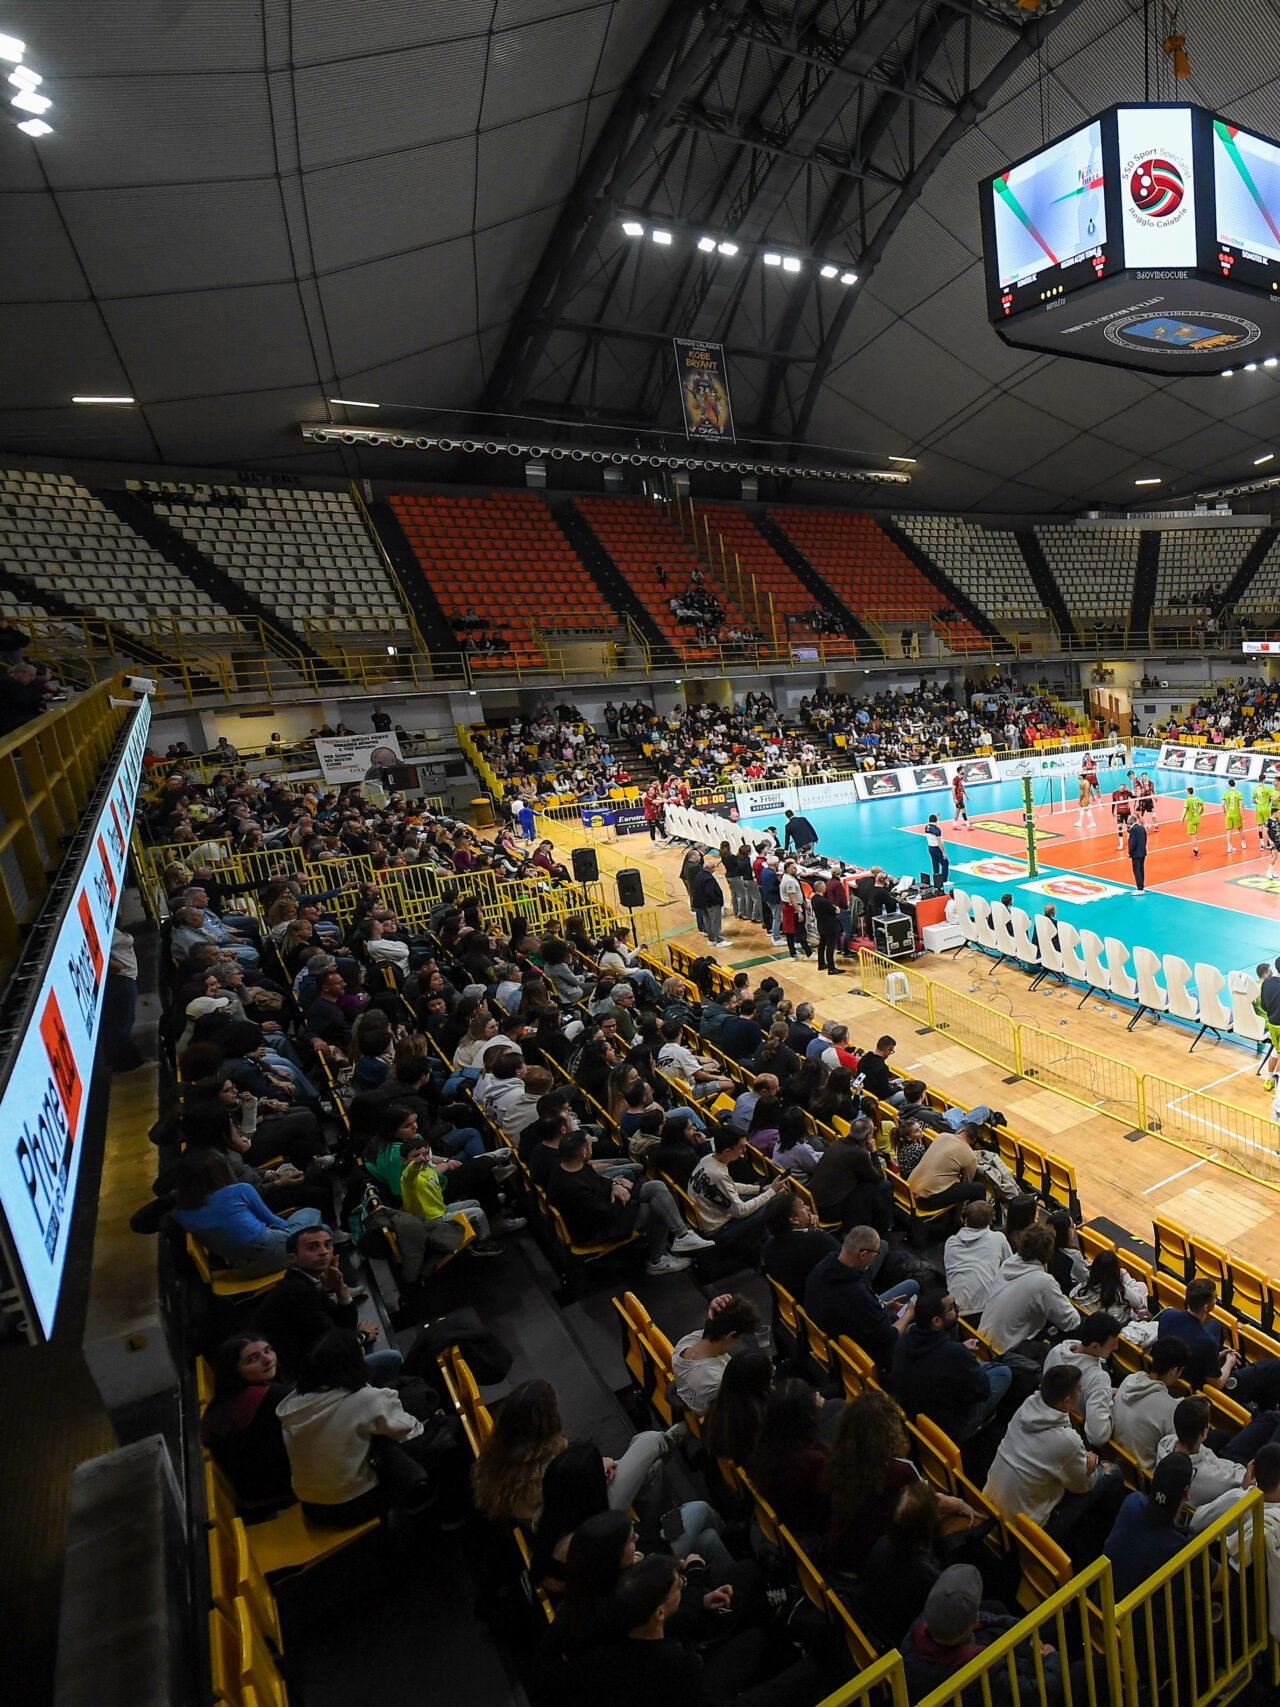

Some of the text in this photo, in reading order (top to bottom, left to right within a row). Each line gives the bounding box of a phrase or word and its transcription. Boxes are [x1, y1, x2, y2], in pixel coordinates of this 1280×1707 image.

[1122, 148, 1191, 179] SSD Sport Specialist
[1129, 208, 1187, 227] Reggio Calabria
[1137, 271, 1188, 279] 360VIDEOCUBE
[689, 350, 711, 360] KOBE
[685, 358, 718, 370] BRYANT
[15, 1016, 75, 1236] Phone hub
